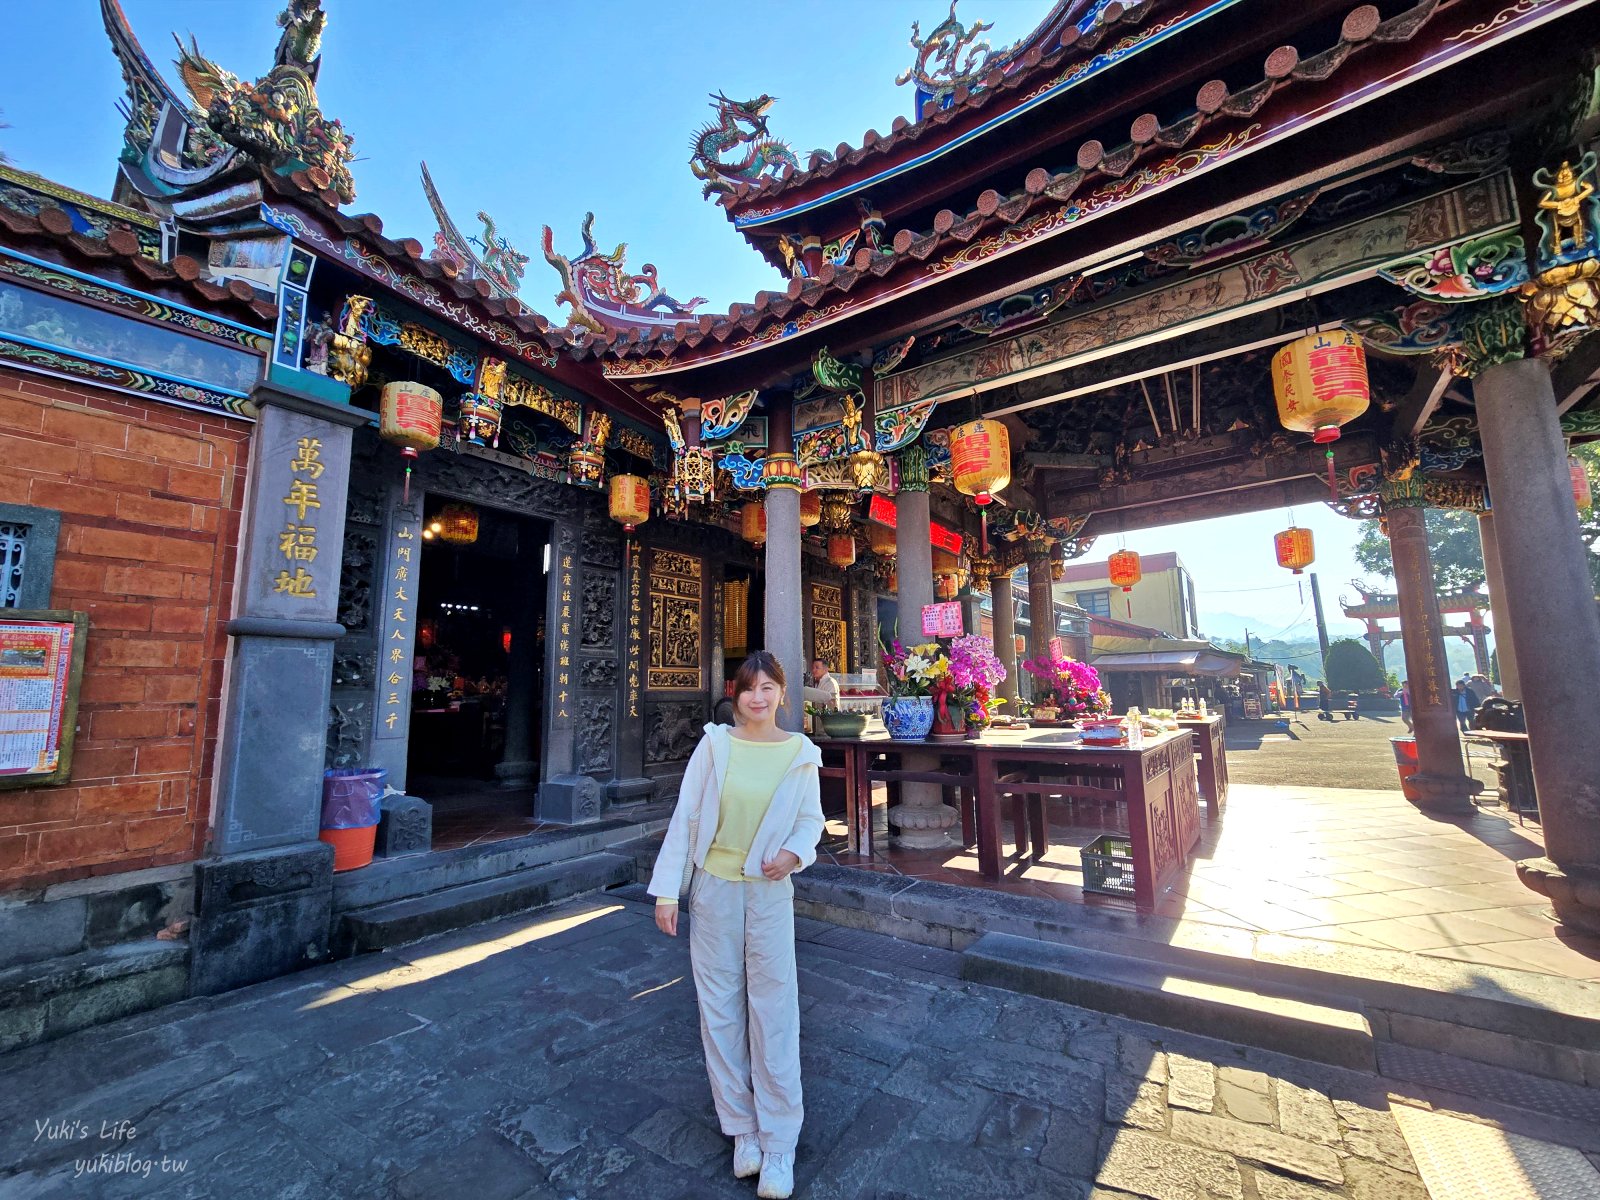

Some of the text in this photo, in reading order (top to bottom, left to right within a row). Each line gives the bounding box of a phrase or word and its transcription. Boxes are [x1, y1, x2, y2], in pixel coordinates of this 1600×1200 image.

[1279, 350, 1300, 413] 國泰民安
[273, 437, 326, 600] 萬年福地
